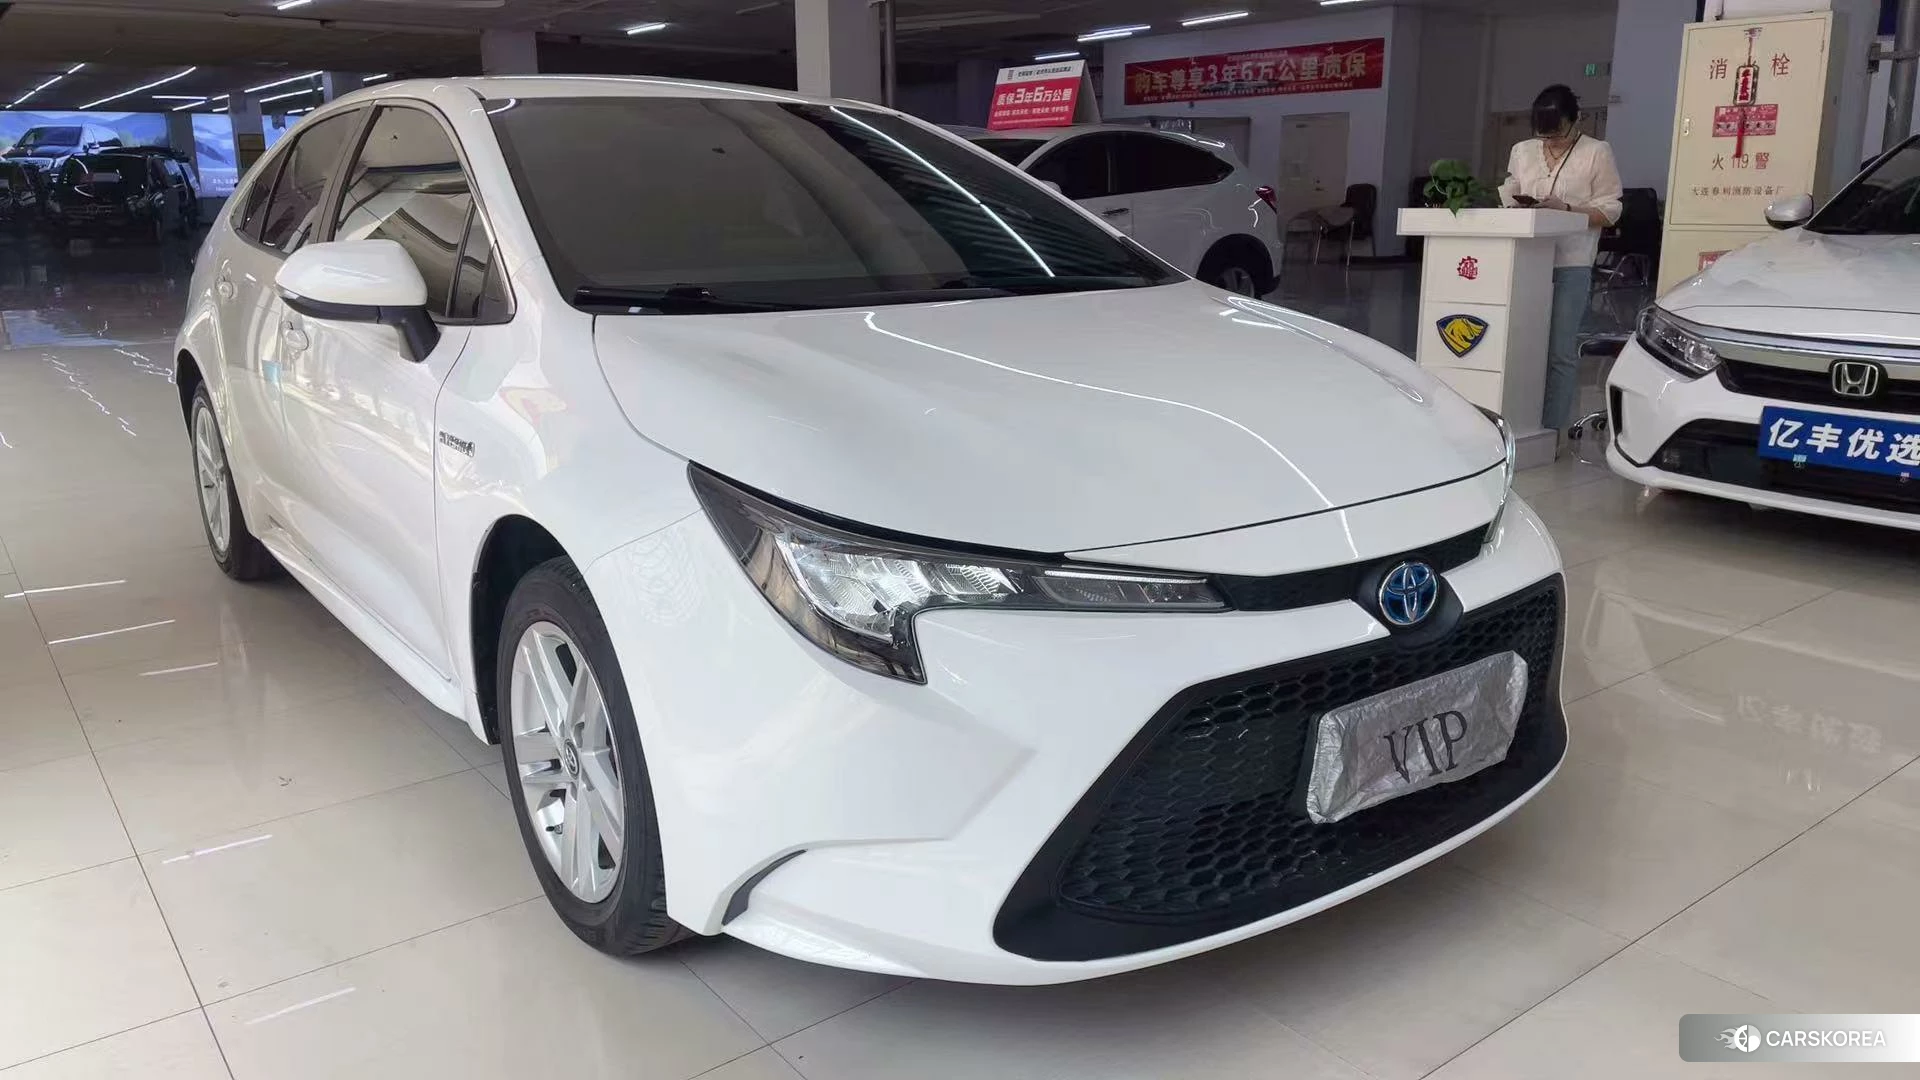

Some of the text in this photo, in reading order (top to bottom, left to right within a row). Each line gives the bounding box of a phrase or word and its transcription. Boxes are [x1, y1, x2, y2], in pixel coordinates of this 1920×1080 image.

[1134, 52, 1367, 94] 购车尊享3年6万公里质保
[1384, 710, 1467, 783] VIP
